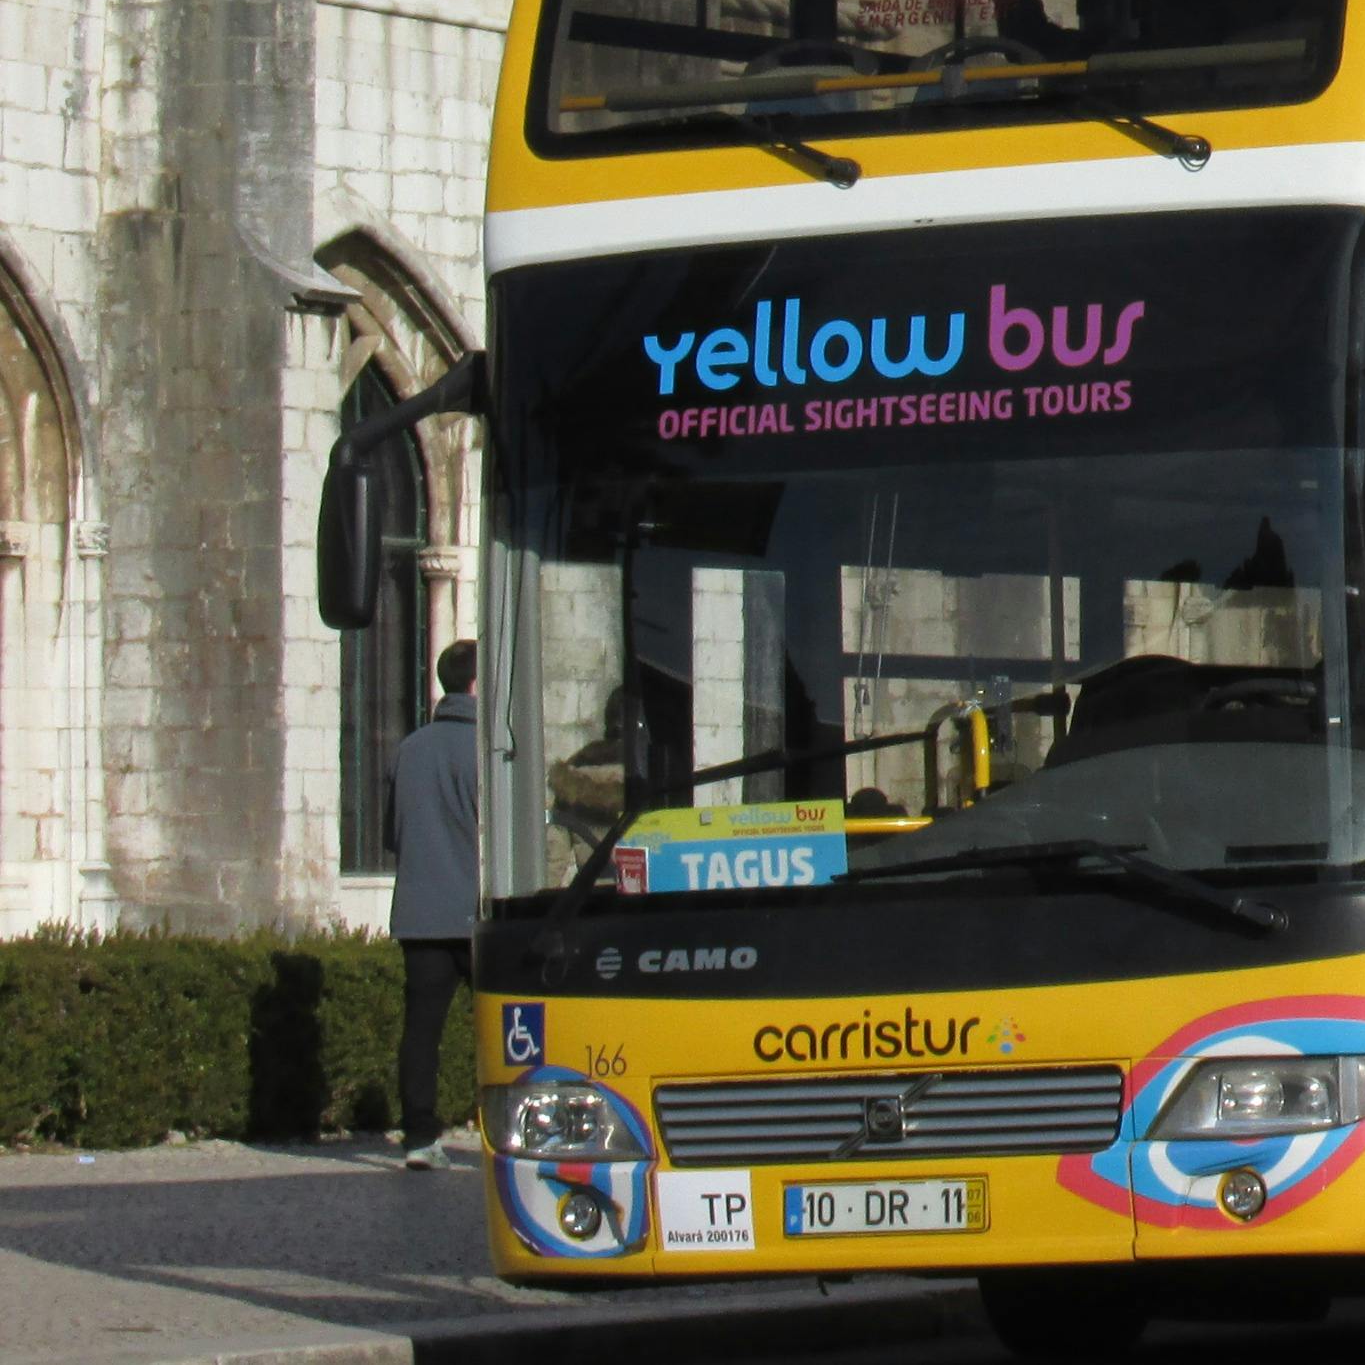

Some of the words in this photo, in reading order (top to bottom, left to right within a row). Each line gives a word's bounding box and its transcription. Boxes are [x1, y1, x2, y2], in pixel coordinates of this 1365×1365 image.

[643, 298, 965, 395] yellow
[989, 283, 1146, 371] bus
[659, 403, 795, 440] OFFICIAL
[804, 389, 1013, 431] SIGHTSEEING
[1023, 380, 1132, 417] TOURS
[795, 804, 827, 823] bus
[681, 847, 816, 891] TAGUS
[638, 946, 758, 973] CAMO
[754, 1006, 980, 1062] carristur
[586, 1044, 628, 1078] 166
[701, 1192, 747, 1226] TP
[706, 1229, 750, 1244] 200176
